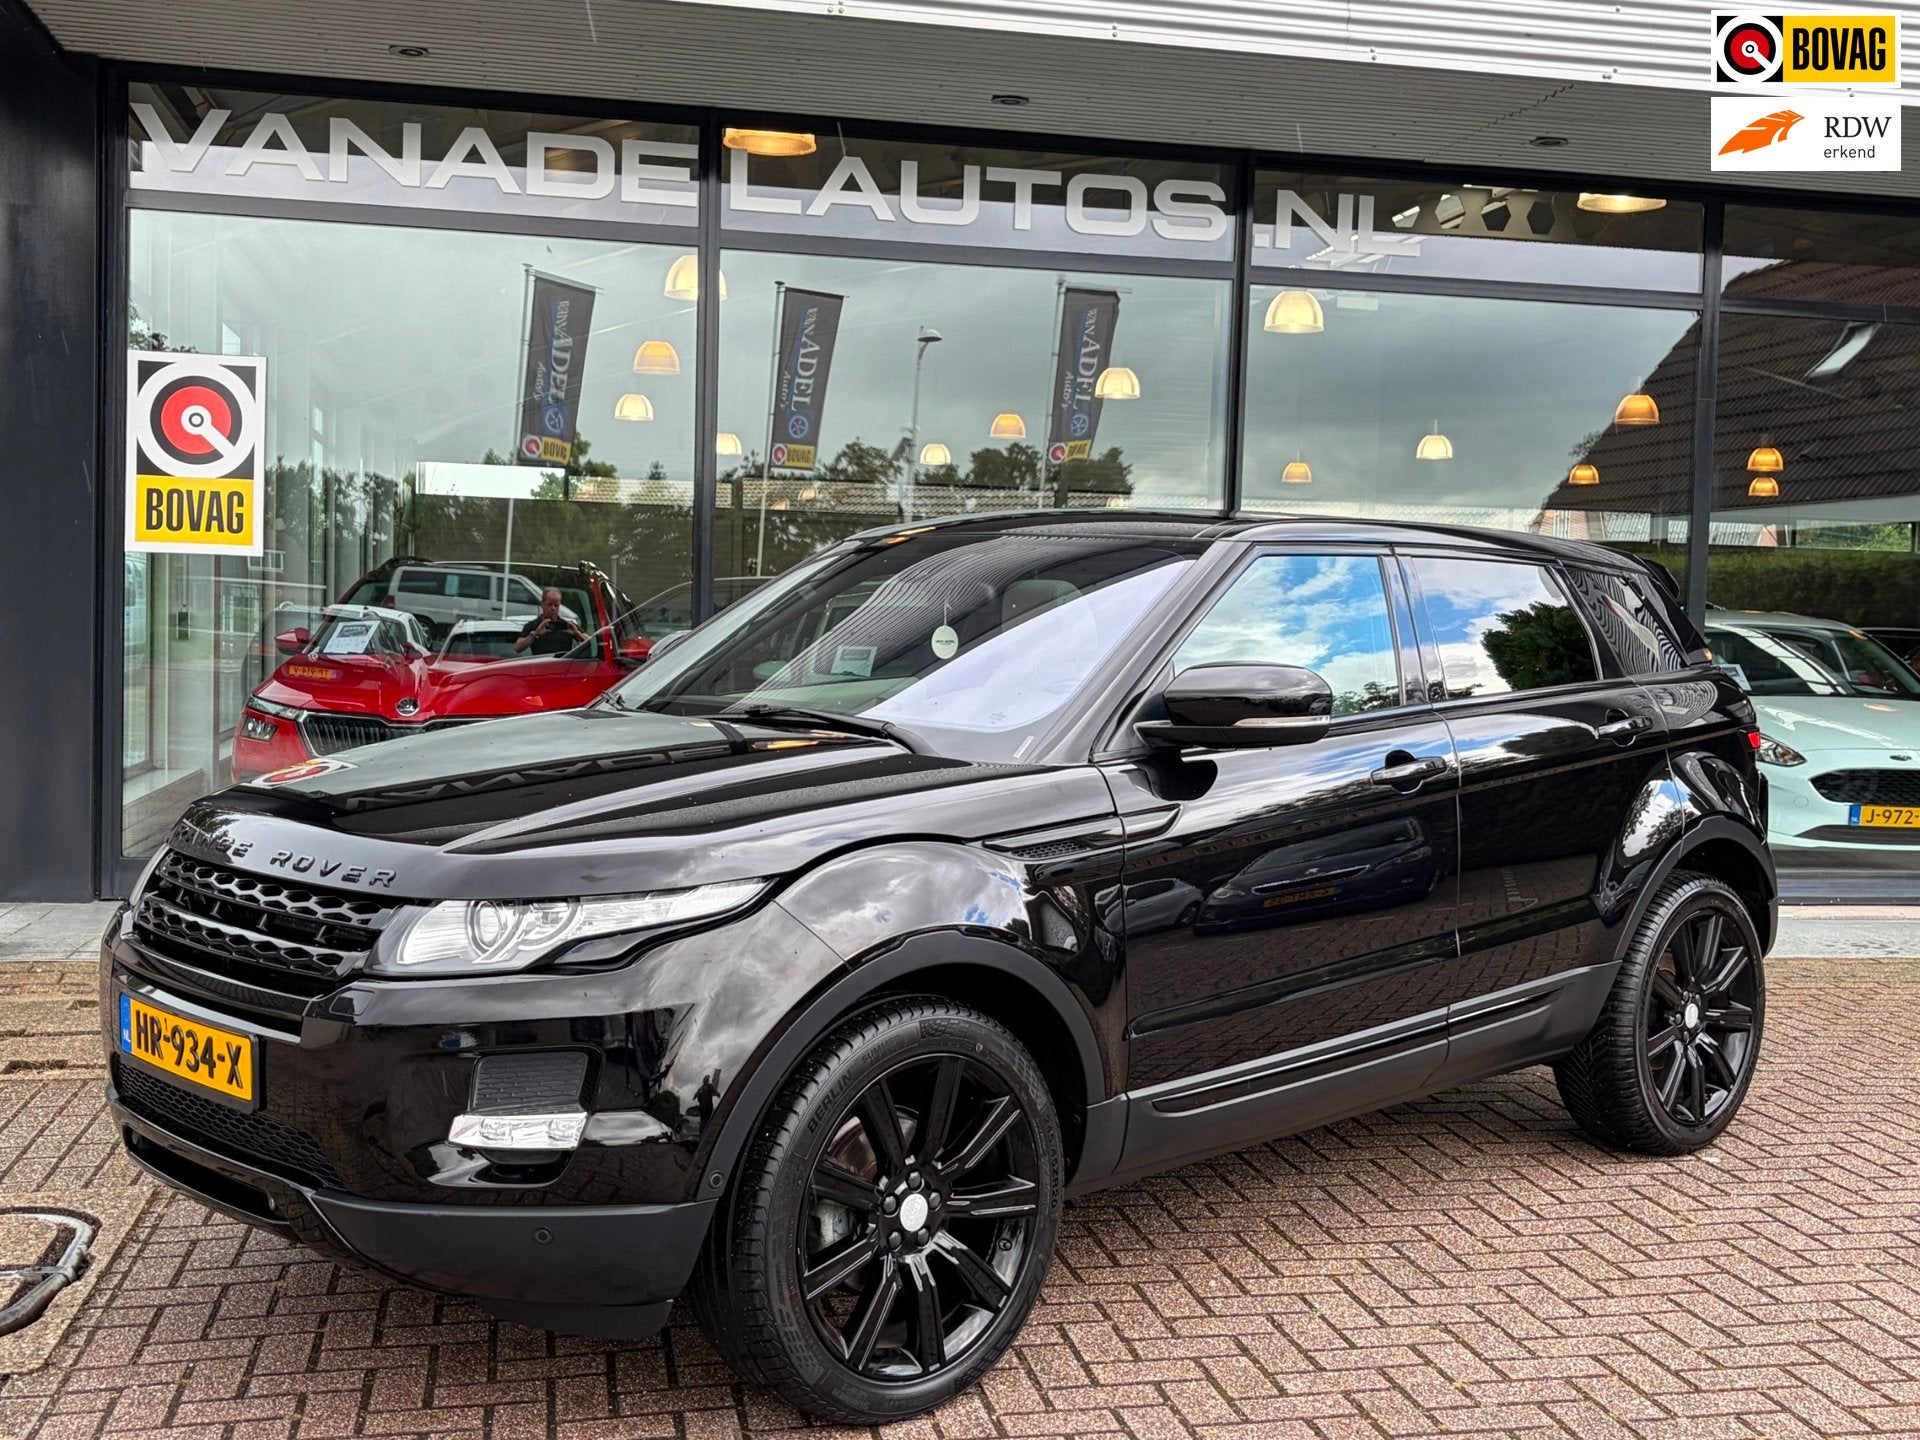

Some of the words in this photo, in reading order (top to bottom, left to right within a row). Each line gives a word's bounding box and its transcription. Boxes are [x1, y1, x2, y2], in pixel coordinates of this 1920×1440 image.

[791, 335, 821, 412] ADEL
[1072, 334, 1101, 411] ADEL
[145, 487, 245, 535] BOVAG
[270, 849, 397, 888] ROVER
[123, 1028, 131, 1043] NL
[135, 1009, 244, 1089] HR-934-X
[807, 1069, 853, 1134] BERLIN
